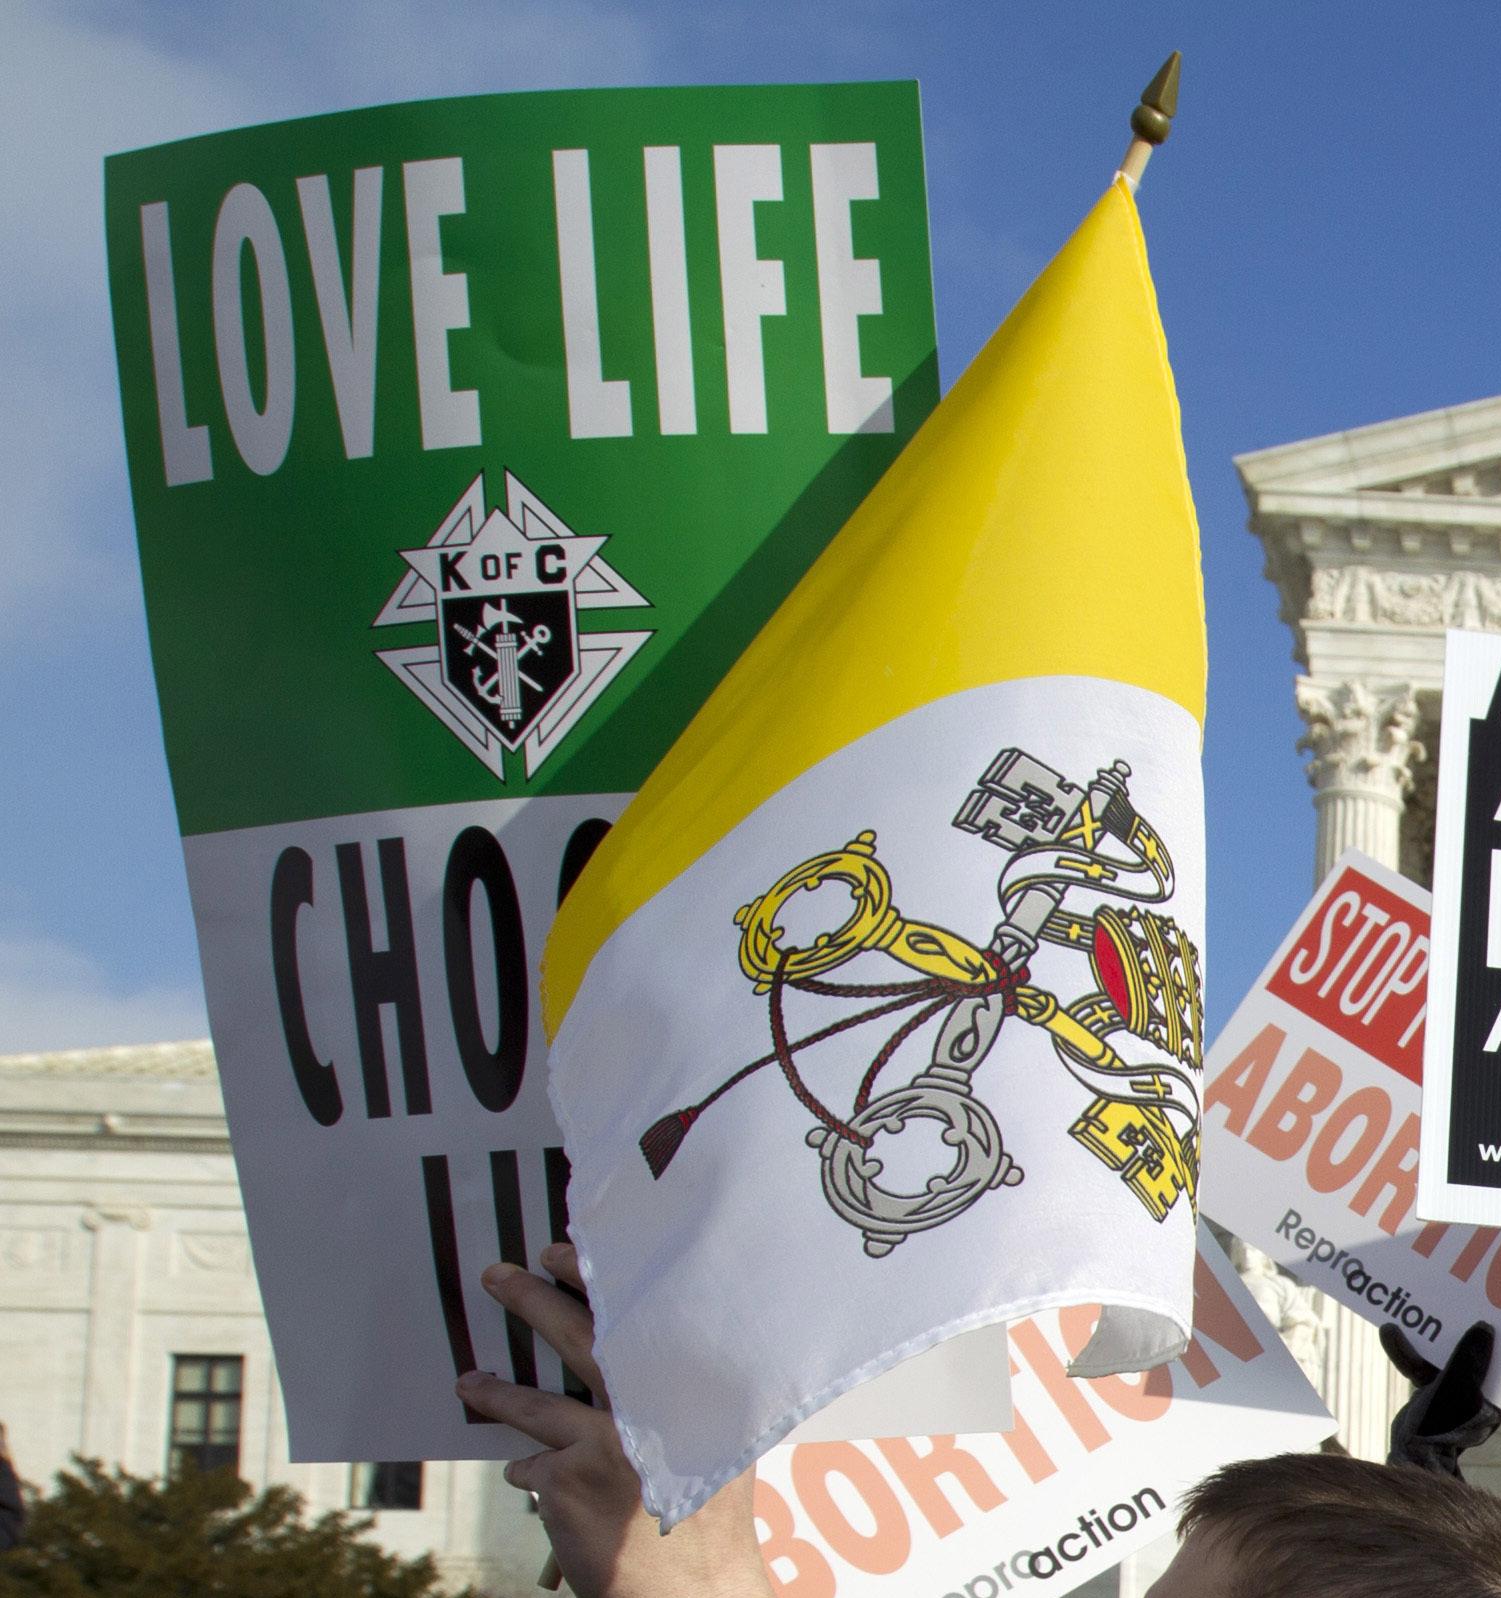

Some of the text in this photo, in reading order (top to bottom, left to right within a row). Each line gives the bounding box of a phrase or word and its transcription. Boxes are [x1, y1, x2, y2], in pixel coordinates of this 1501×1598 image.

[140, 141, 895, 487] LOVE LIFE
[440, 544, 567, 592] K OF C
[271, 818, 612, 1127] CHO
[1289, 890, 1429, 1025] STOP
[1275, 1208, 1443, 1343] Reproaction
